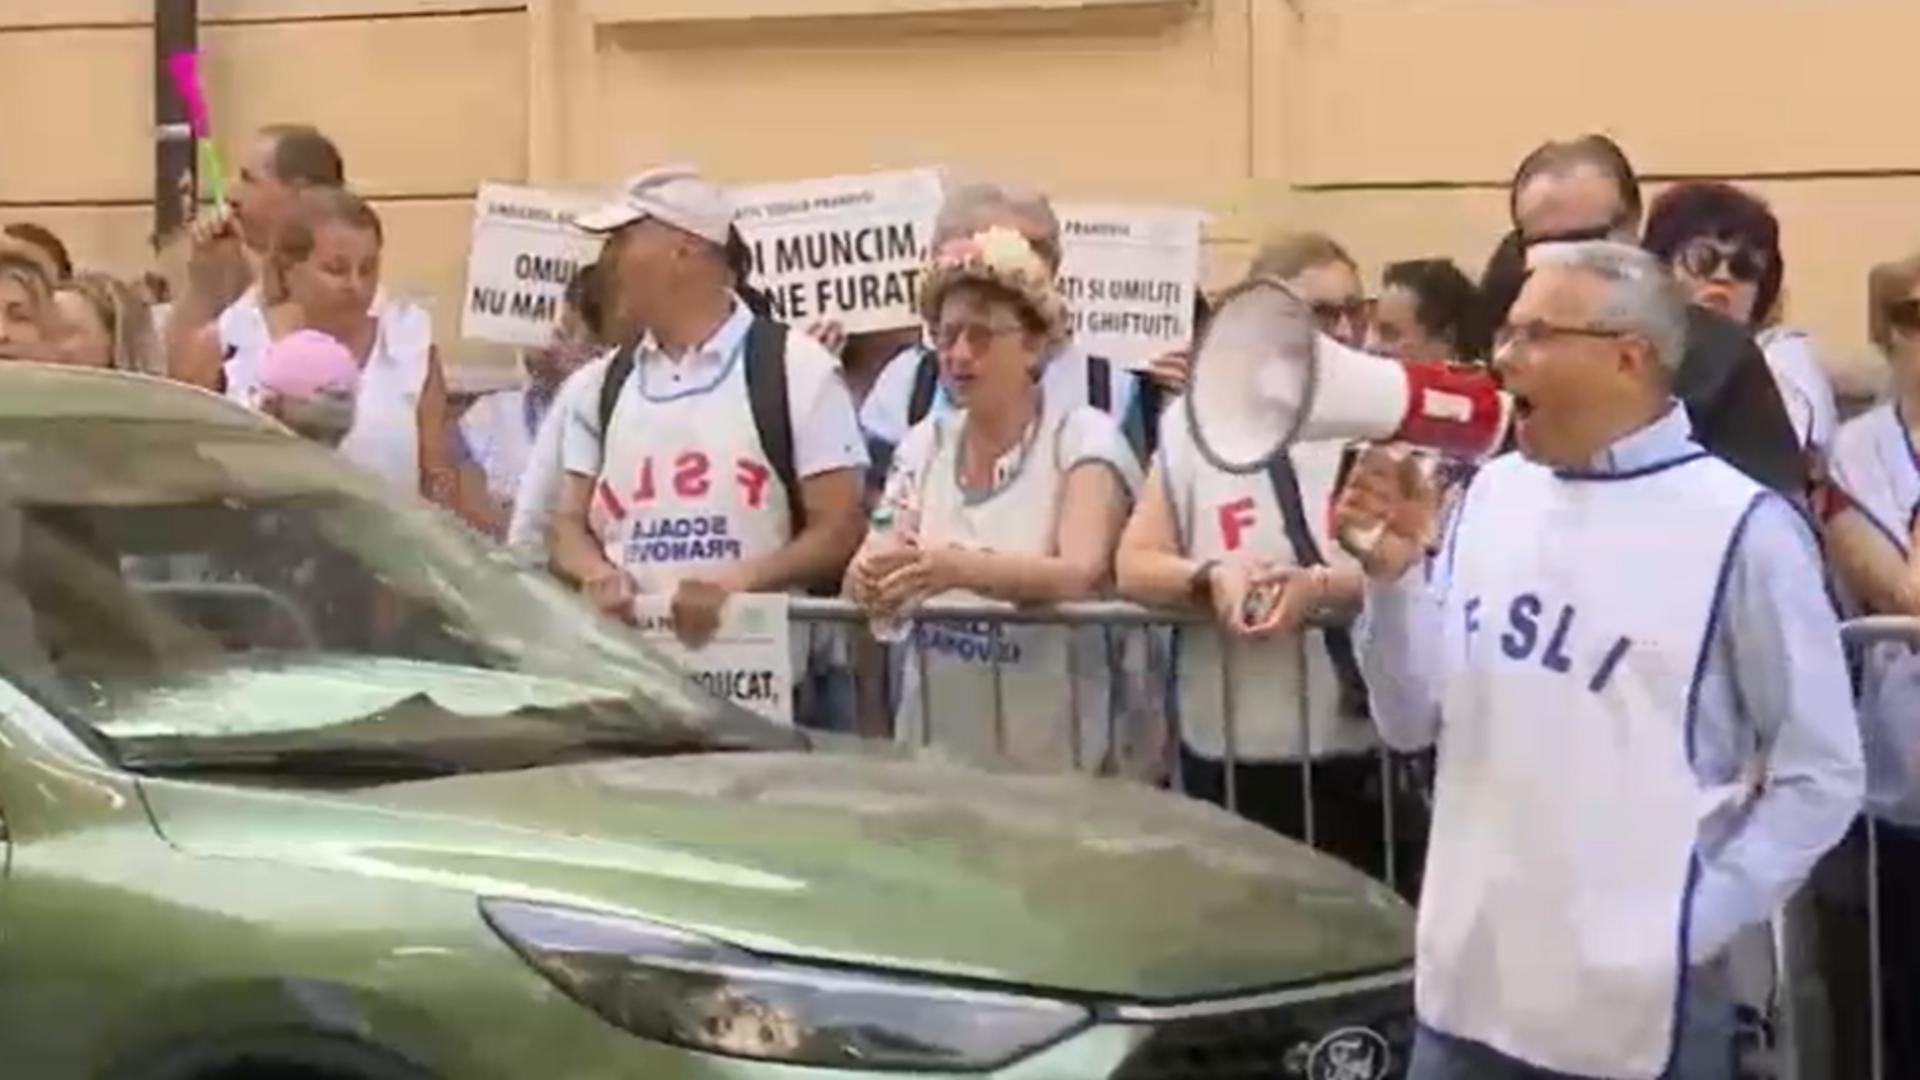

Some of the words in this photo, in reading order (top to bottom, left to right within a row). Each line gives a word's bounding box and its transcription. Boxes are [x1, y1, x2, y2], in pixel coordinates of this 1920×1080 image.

[776, 222, 927, 274] MUNCIM,
[472, 286, 505, 316] NU
[509, 296, 555, 322] MAI
[765, 284, 807, 319] NE
